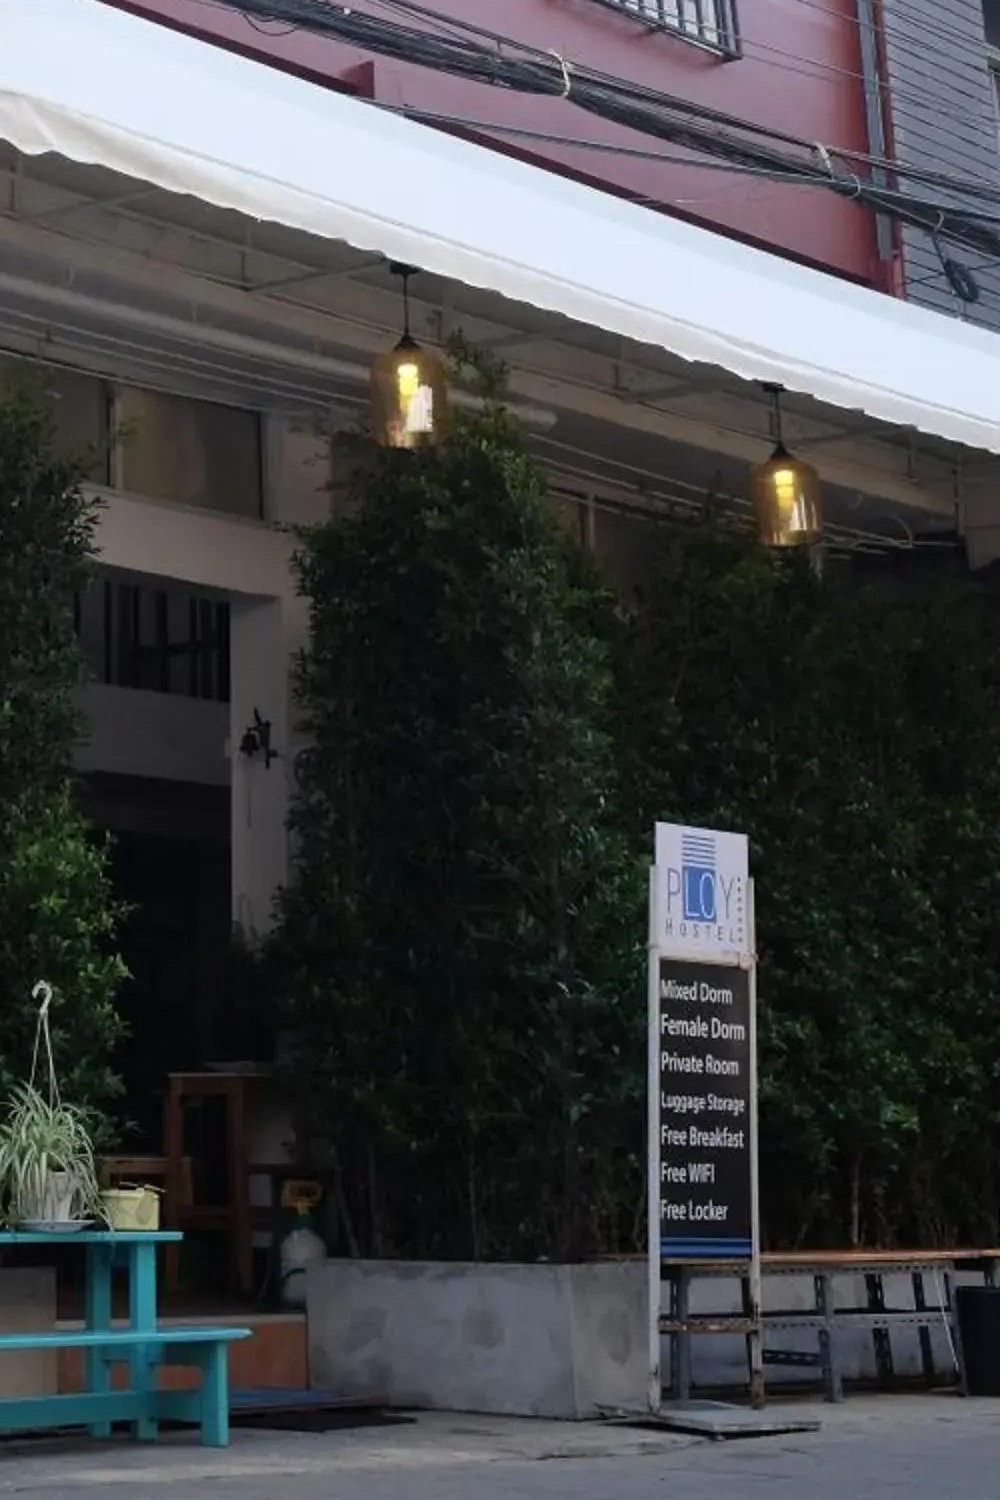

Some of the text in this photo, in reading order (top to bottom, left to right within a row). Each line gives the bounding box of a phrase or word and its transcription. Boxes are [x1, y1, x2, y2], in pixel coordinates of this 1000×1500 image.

[667, 867, 734, 921] PLOY
[665, 920, 735, 943] HOSTEL
[661, 979, 733, 1004] Mixed Dorm
[661, 1013, 745, 1041] Female Dorm
[661, 1051, 739, 1075] Private Room
[661, 1091, 745, 1116] Luggage Storage
[661, 1124, 745, 1148] Free Breakfast
[661, 1161, 687, 1183] Free
[660, 1199, 729, 1221] Free Locker
